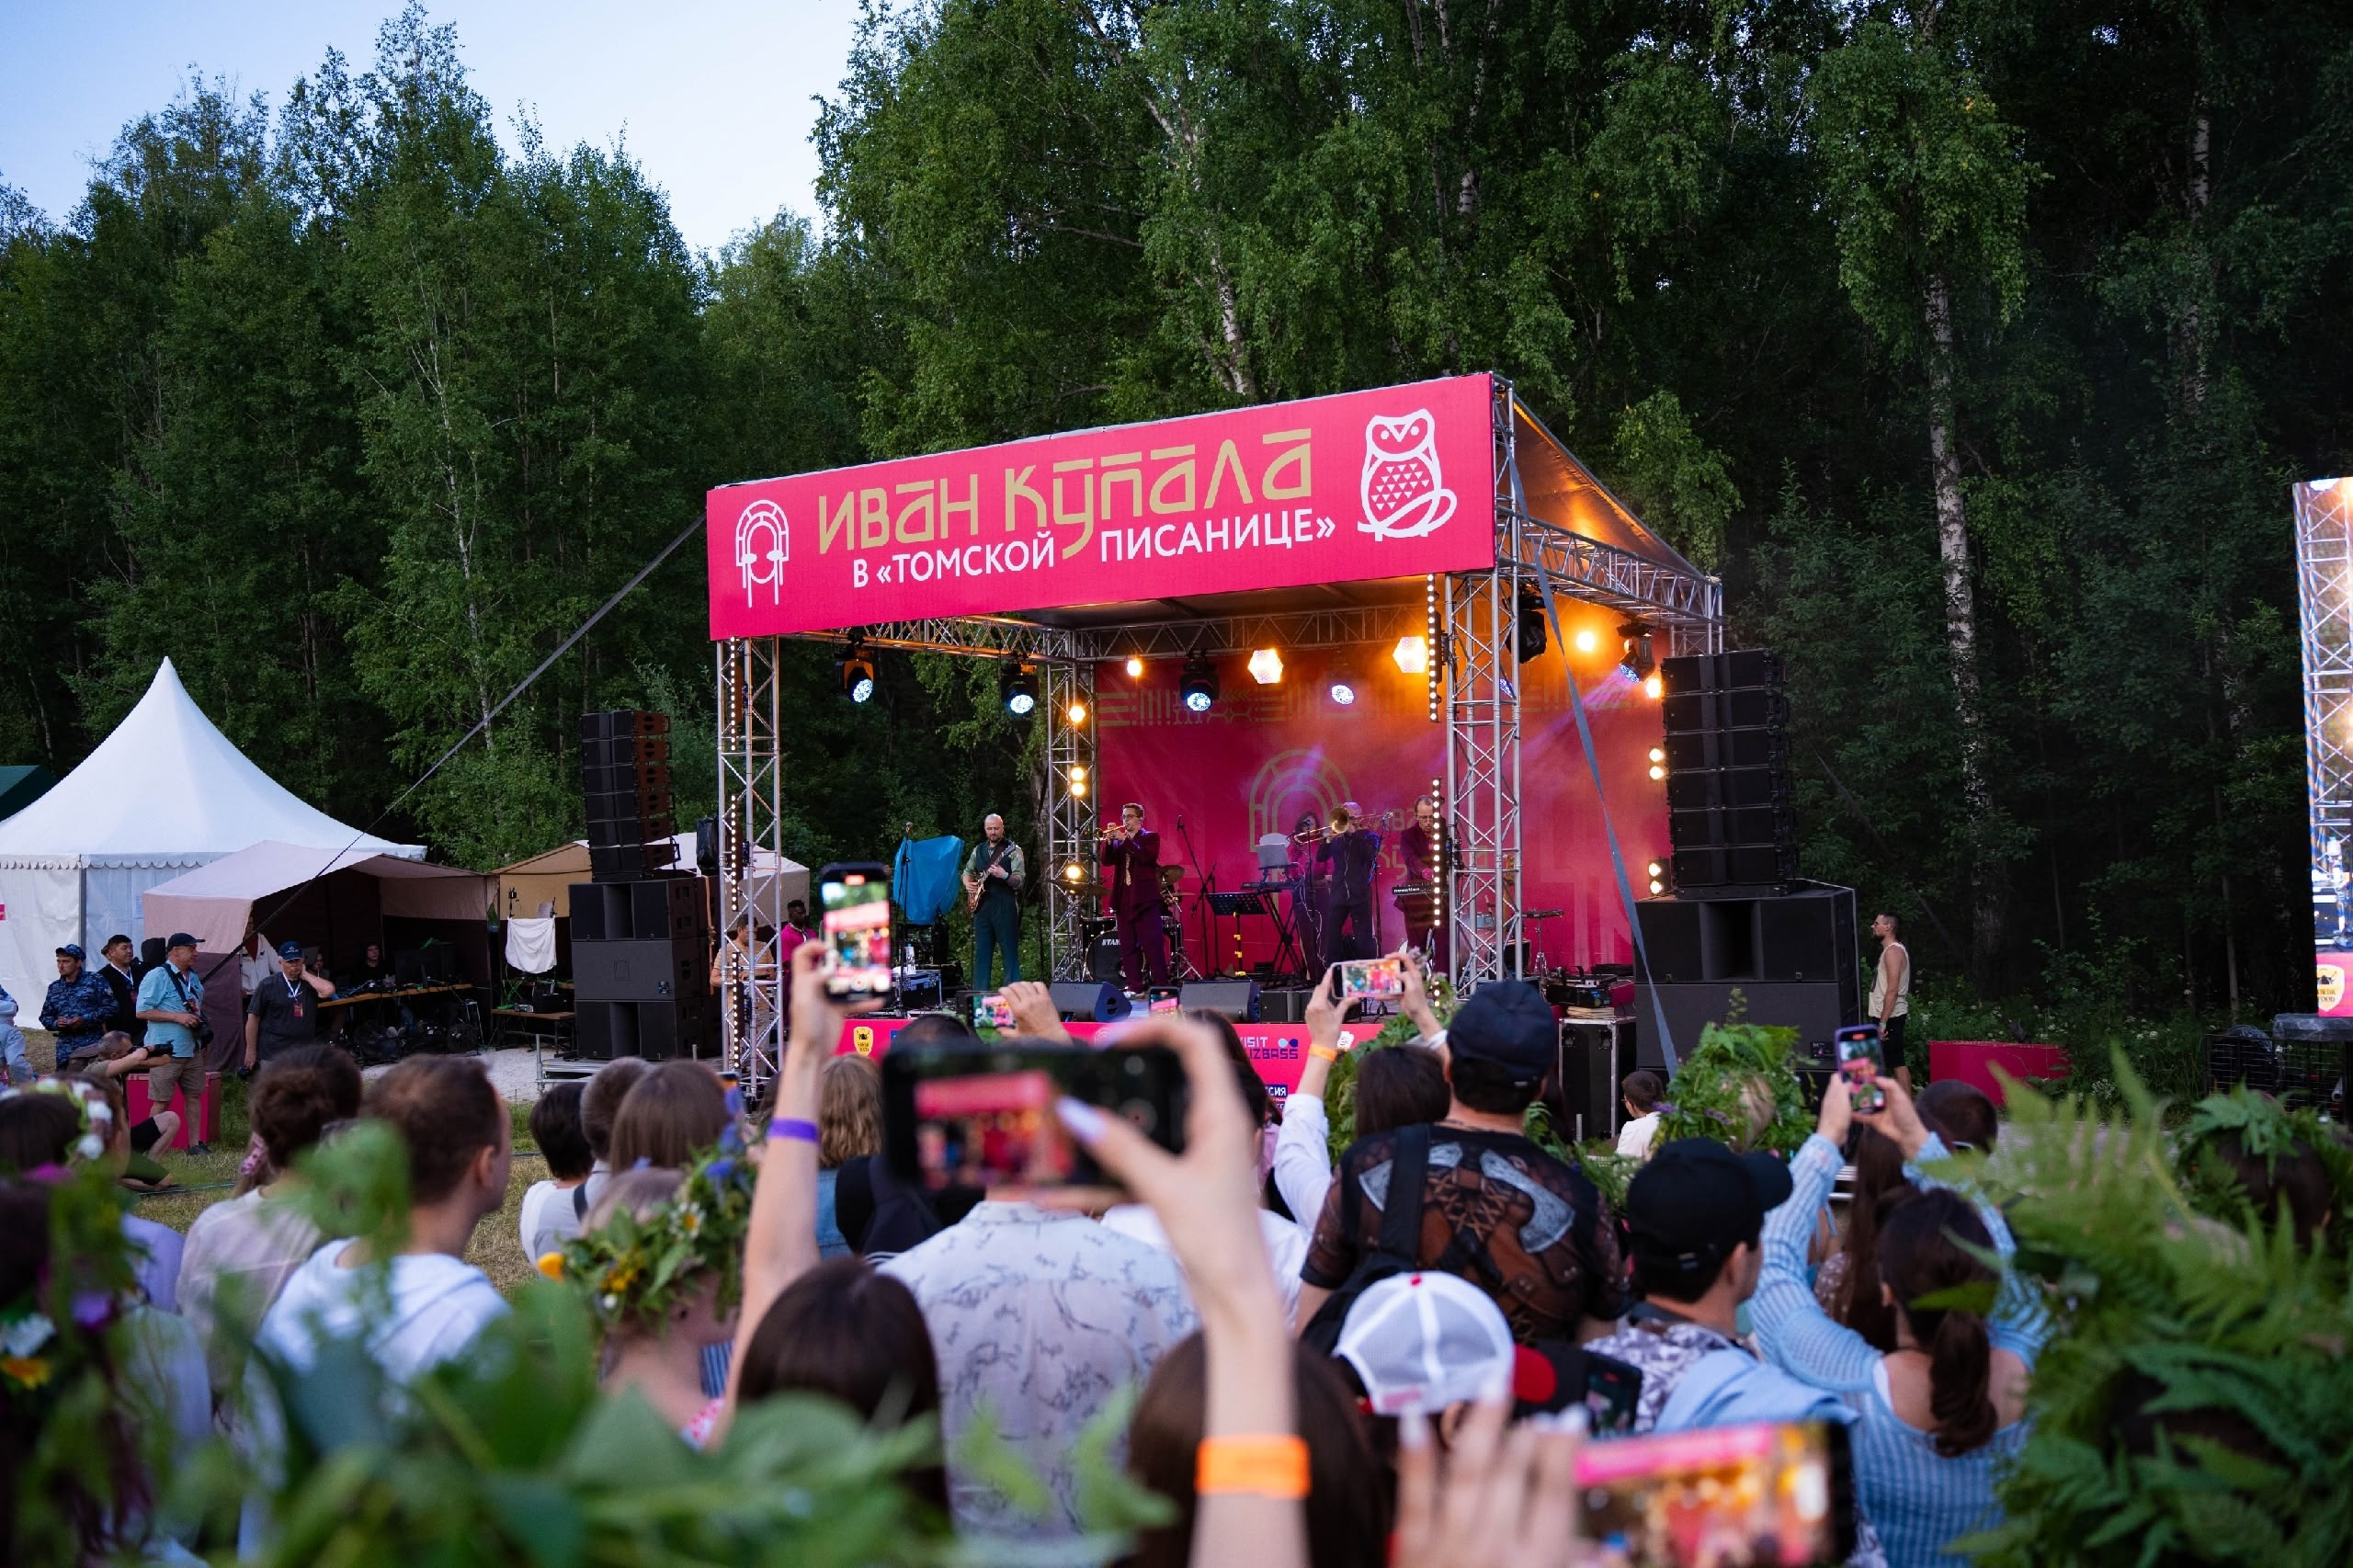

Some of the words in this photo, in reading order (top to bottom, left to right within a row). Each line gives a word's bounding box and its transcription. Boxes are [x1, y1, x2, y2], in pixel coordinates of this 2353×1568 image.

[853, 558, 869, 588] В
[876, 530, 1054, 585] «ТОМСКОЙ
[1101, 508, 1337, 563] ПИСАНИЦЕ»
[1249, 1049, 1299, 1060] ZBASS
